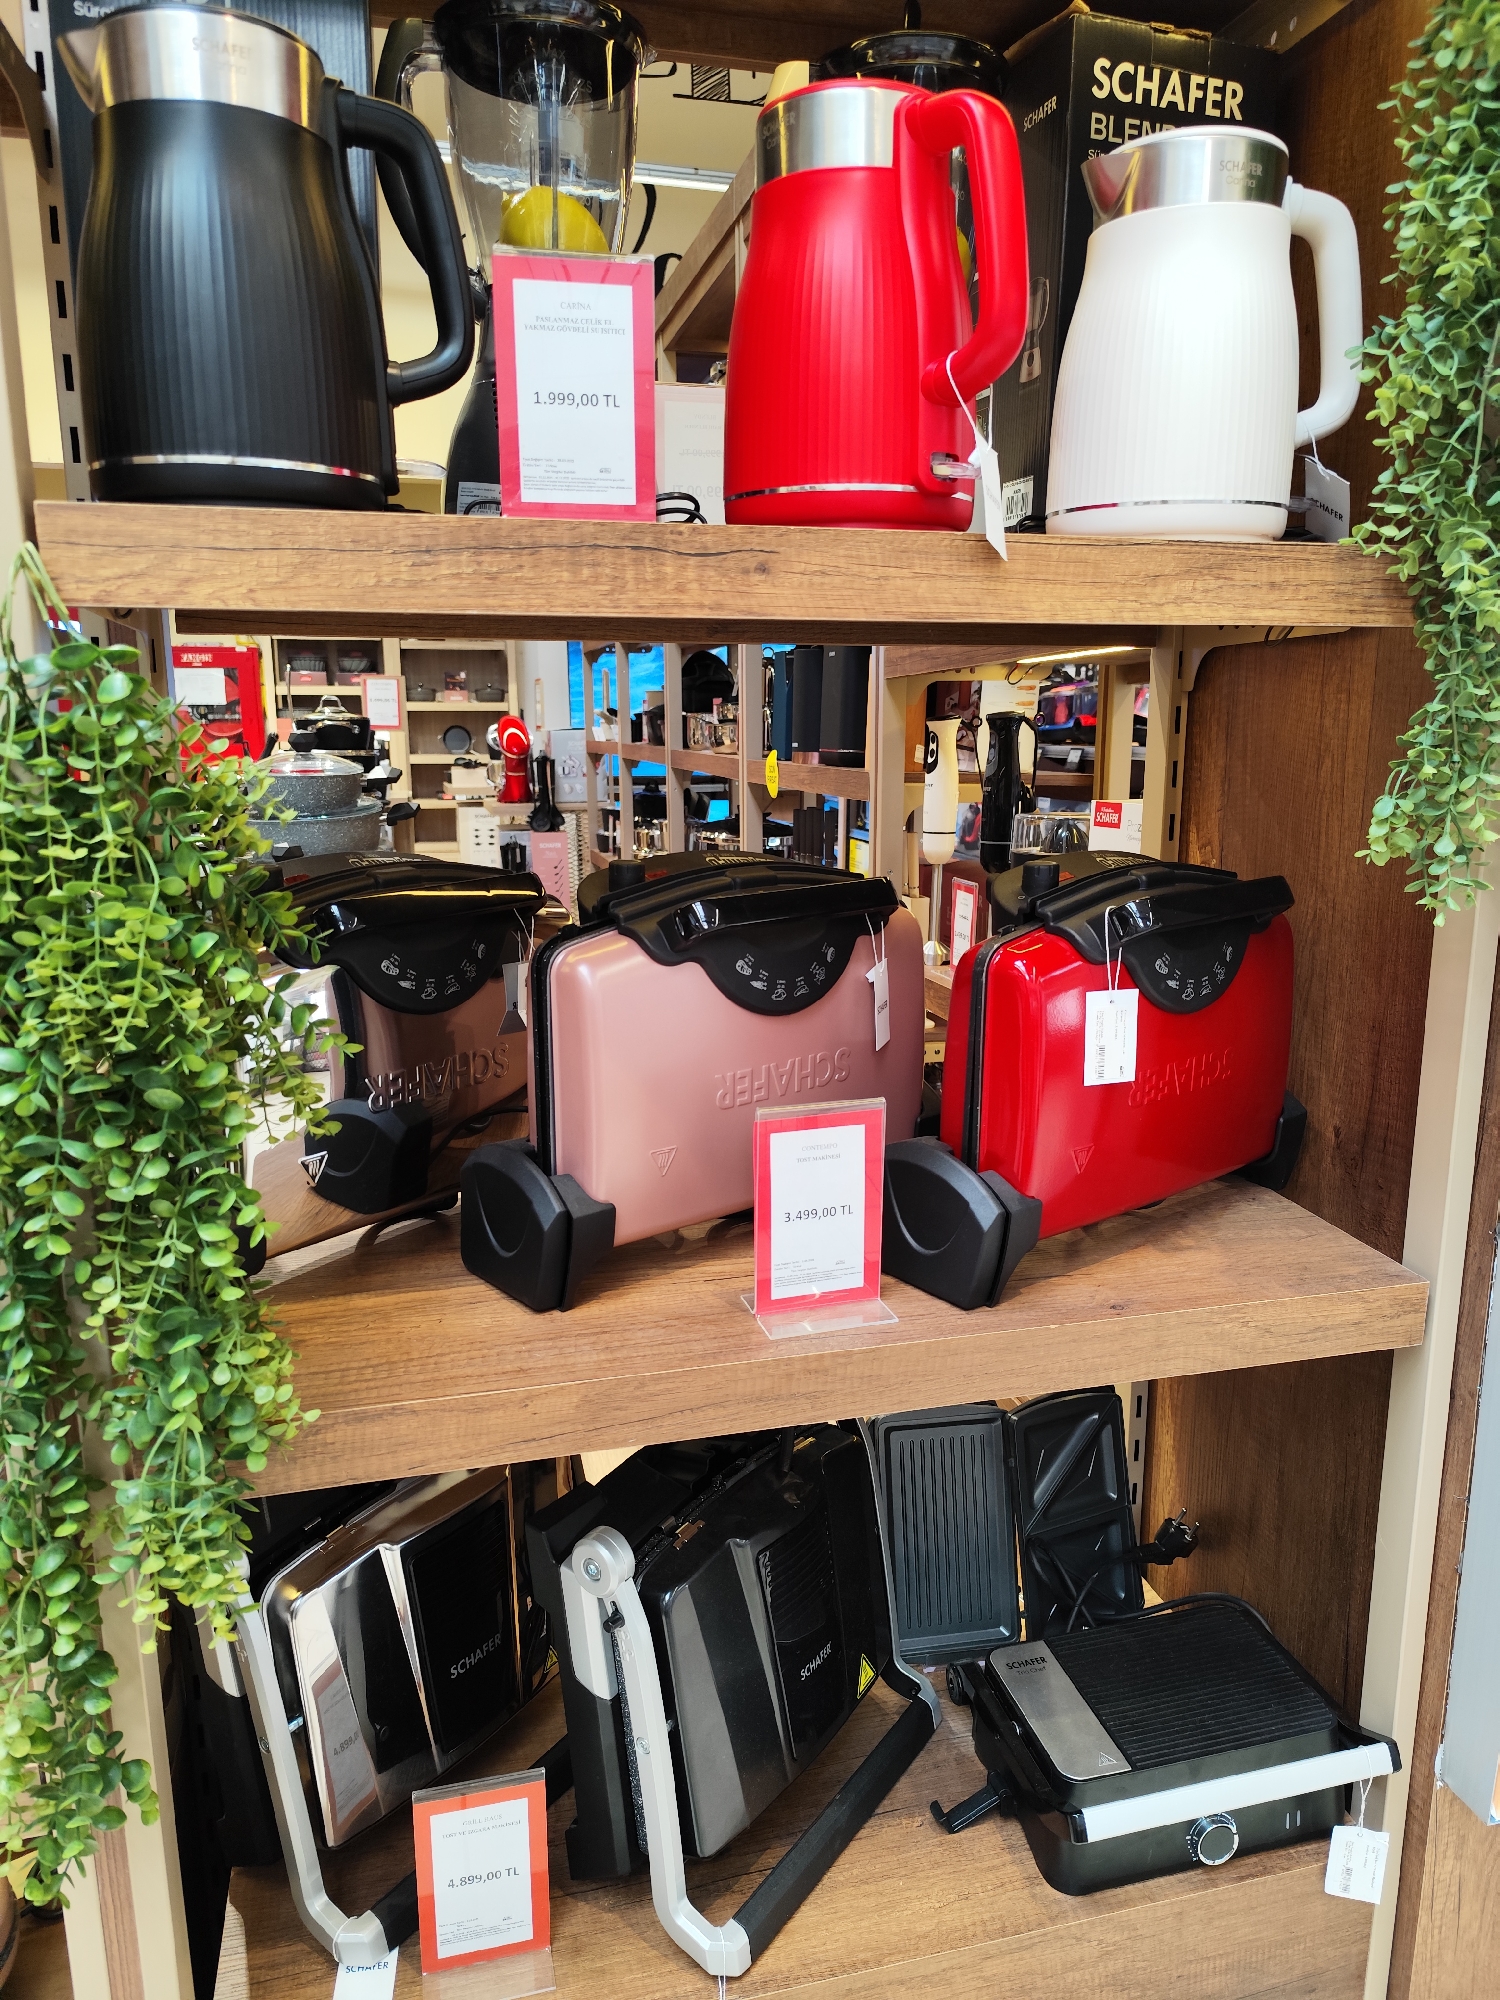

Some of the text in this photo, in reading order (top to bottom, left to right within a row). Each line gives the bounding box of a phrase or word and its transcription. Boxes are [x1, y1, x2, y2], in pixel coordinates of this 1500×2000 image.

[1091, 57, 1244, 121] SCHAFER
[1023, 96, 1057, 133] SCHAFER
[1090, 112, 1176, 145] BLEN
[1219, 160, 1263, 177] SCHAFER
[560, 301, 592, 311] CARİNA
[523, 324, 556, 332] YAKMAZ
[535, 315, 580, 325] PASLANMAZ
[533, 391, 621, 409] 1.999,00 TL
[1310, 498, 1344, 522] CHAFER
[1096, 812, 1119, 824] SCHAFER
[364, 1042, 510, 1114] SCHAFER
[714, 1047, 851, 1110] SCHAFER
[801, 1143, 838, 1152] CONTEMPO
[796, 1152, 841, 1164] TOST MAKİNESİ
[784, 1204, 854, 1223] 3.499,00 TL
[450, 1633, 501, 1679] SCHAFER
[801, 1644, 832, 1680] SCHAFER
[1006, 1657, 1047, 1670] SCHAFER
[447, 1867, 520, 1889] 4.899,00 TL
